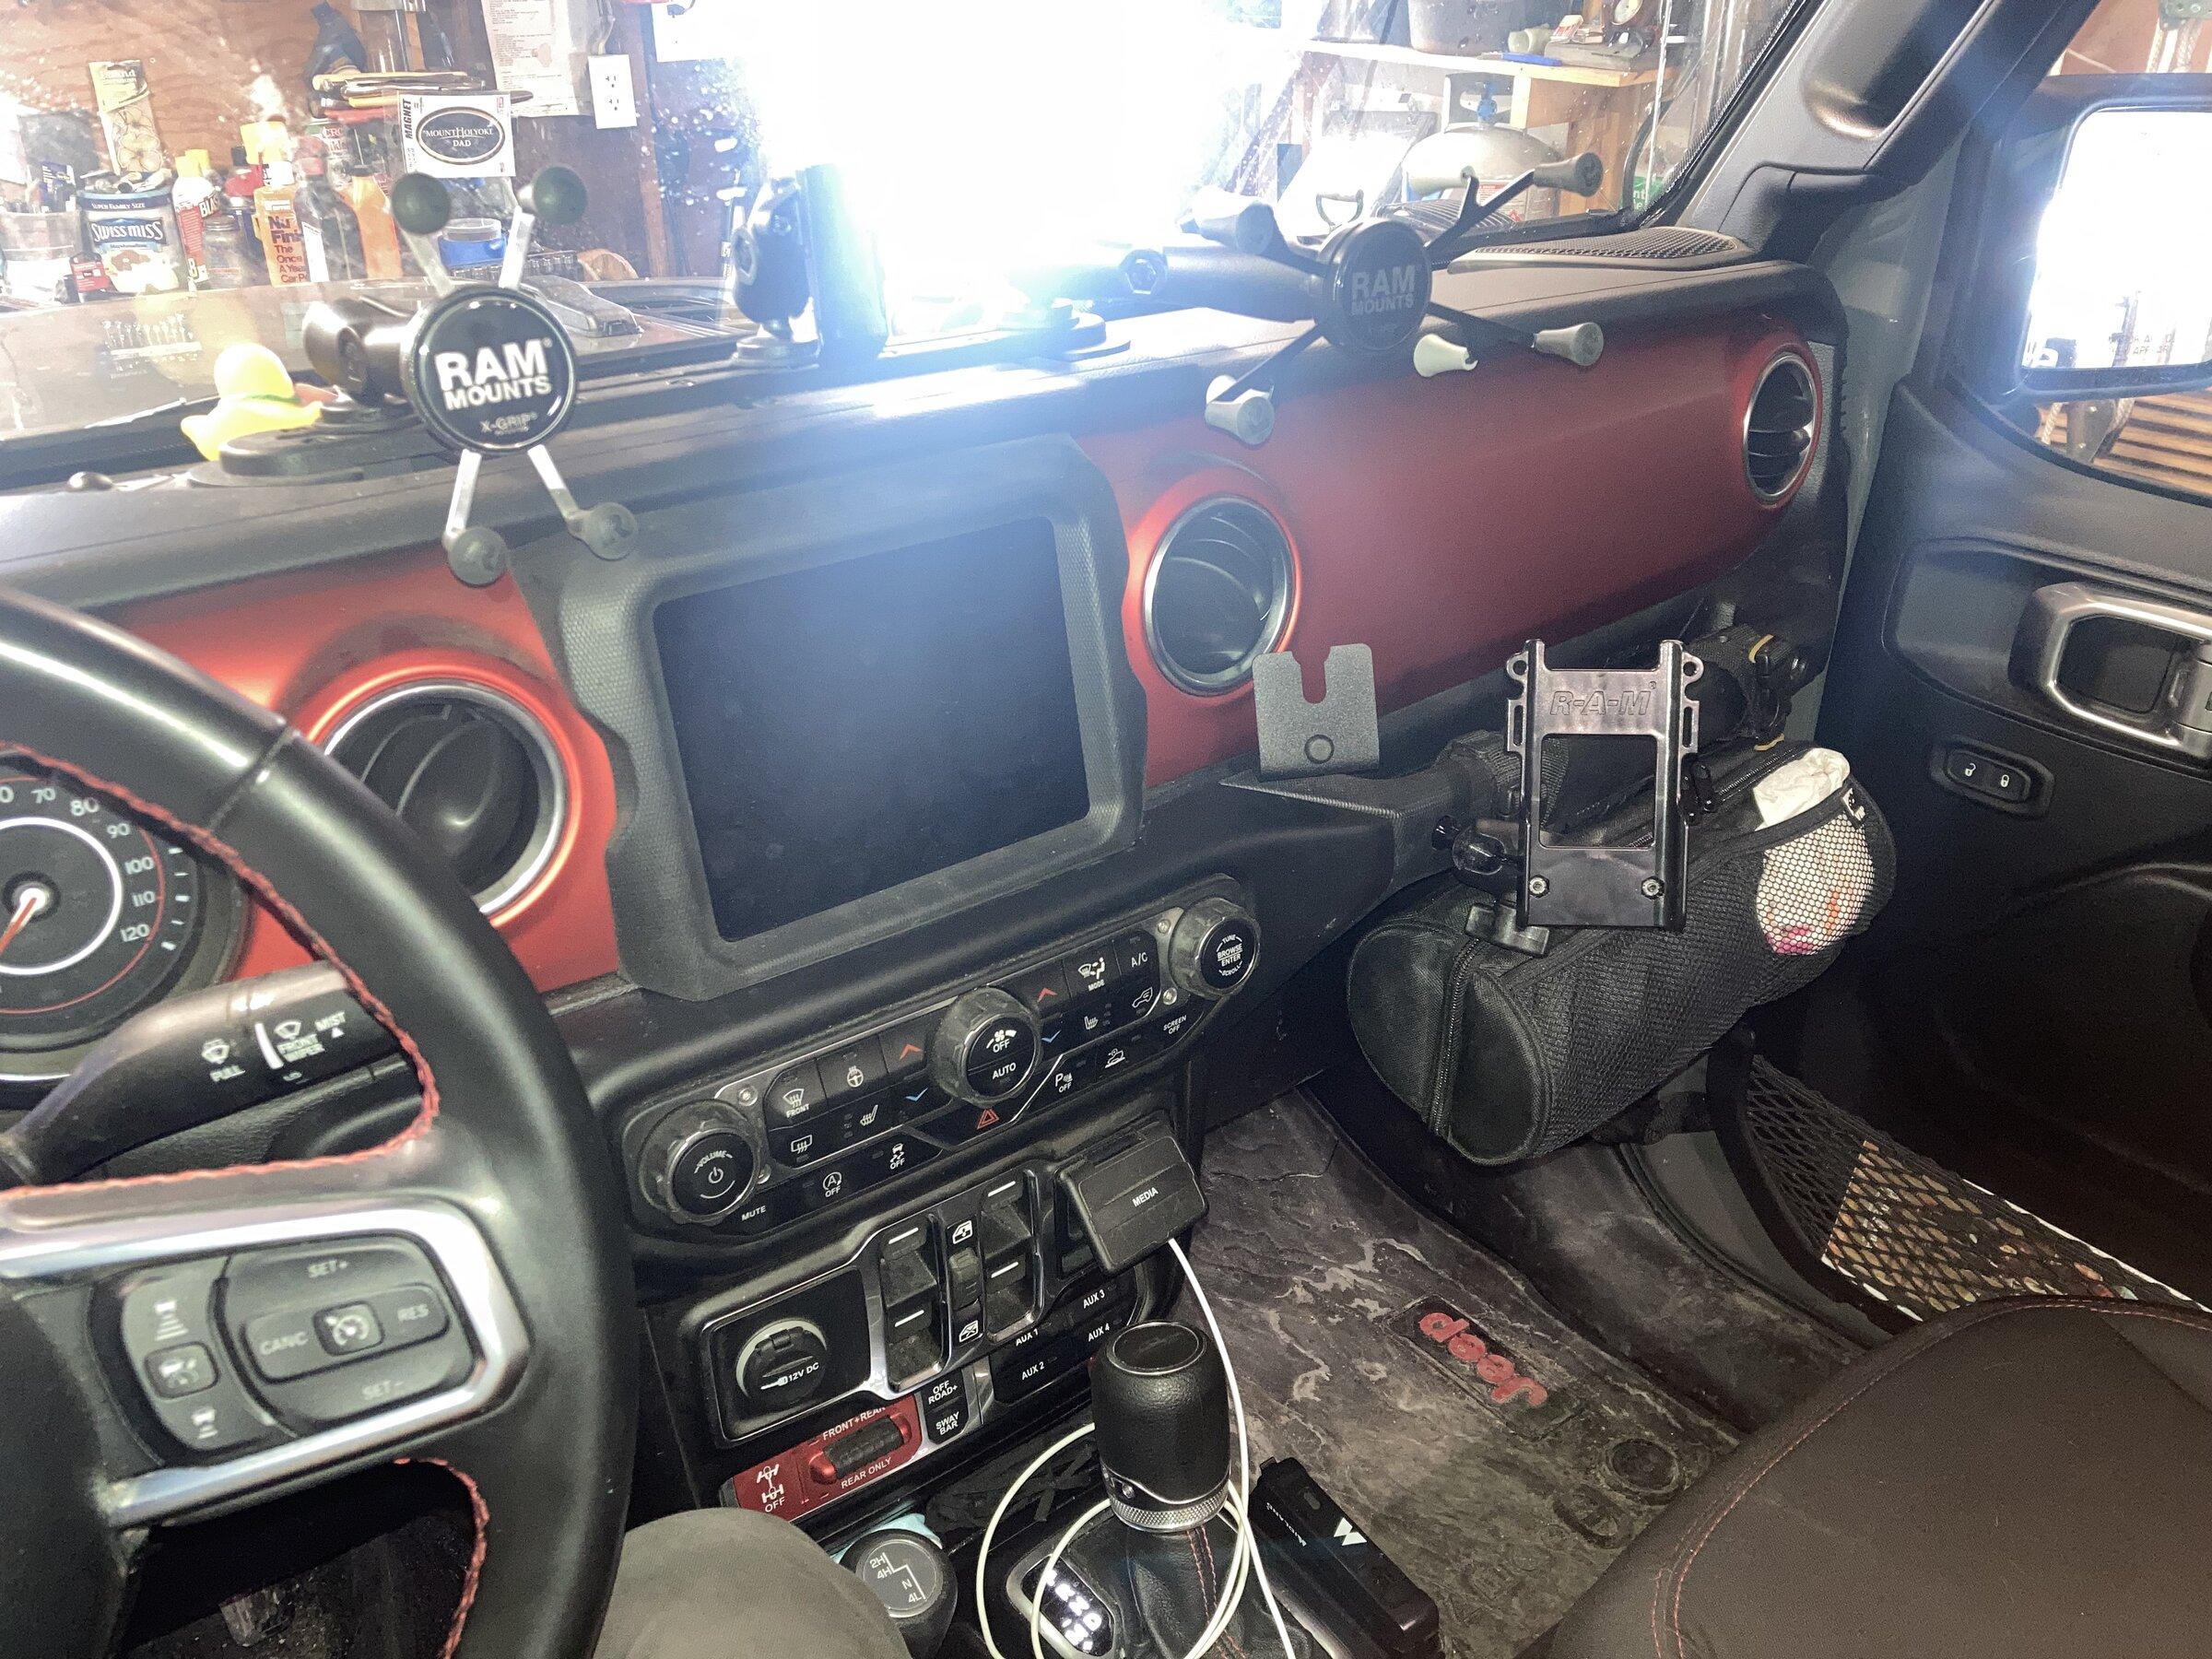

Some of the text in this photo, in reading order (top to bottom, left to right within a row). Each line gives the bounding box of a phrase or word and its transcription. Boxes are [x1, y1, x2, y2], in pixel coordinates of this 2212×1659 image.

[403, 98, 414, 139] MAGNET
[425, 128, 457, 138] MOUNT
[453, 139, 471, 147] DAD
[274, 244, 294, 254] The
[1351, 265, 1416, 301] RAM
[1351, 292, 1415, 315] MOUNTS
[434, 338, 548, 392] RAM
[443, 375, 552, 411] MOUNTS
[30, 787, 56, 804] 70
[69, 797, 100, 817] 80
[107, 823, 130, 839] 90
[124, 856, 155, 875] 100
[132, 890, 156, 907] 110
[120, 924, 150, 943] 120
[1222, 934, 1237, 945] TUNE
[1217, 943, 1243, 959] BROWSE
[1131, 952, 1148, 968] A/C
[1220, 953, 1241, 968] ENTER
[1221, 964, 1241, 977] SCROLL
[1088, 979, 1106, 992] MODE
[313, 1011, 347, 1032] MIST
[1163, 1015, 1187, 1031] SCREEN
[1168, 1024, 1181, 1035] OFF
[993, 1040, 1010, 1053] OFF
[992, 1062, 1017, 1080] AUTO
[1058, 1081, 1072, 1093] OFF
[786, 1103, 810, 1119] FRONT
[696, 1149, 727, 1169] VOLUME
[889, 1158, 905, 1171] OFF
[825, 1186, 841, 1198] OFF
[1132, 1187, 1159, 1208] MEDIA
[741, 1205, 767, 1222] MUTE
[1082, 1288, 1106, 1310] AUX 3
[1015, 1332, 1033, 1347] AUX
[1088, 1322, 1111, 1342] AUX 4
[260, 1331, 310, 1356] CANC
[1418, 1312, 1548, 1407] Jeep
[787, 1361, 819, 1382] 12V DC
[1021, 1360, 1045, 1381] AUX 2
[927, 1384, 959, 1406] ROAD+
[932, 1380, 950, 1394] OFF
[935, 1411, 960, 1431] SWAY
[939, 1420, 959, 1437] BAR
[841, 1456, 892, 1489] REAR ONLY
[764, 1495, 786, 1513] OFF
[869, 1555, 885, 1570] 2H
[877, 1565, 892, 1580] 4H
[901, 1577, 913, 1591] N
[908, 1591, 923, 1603] 4L
